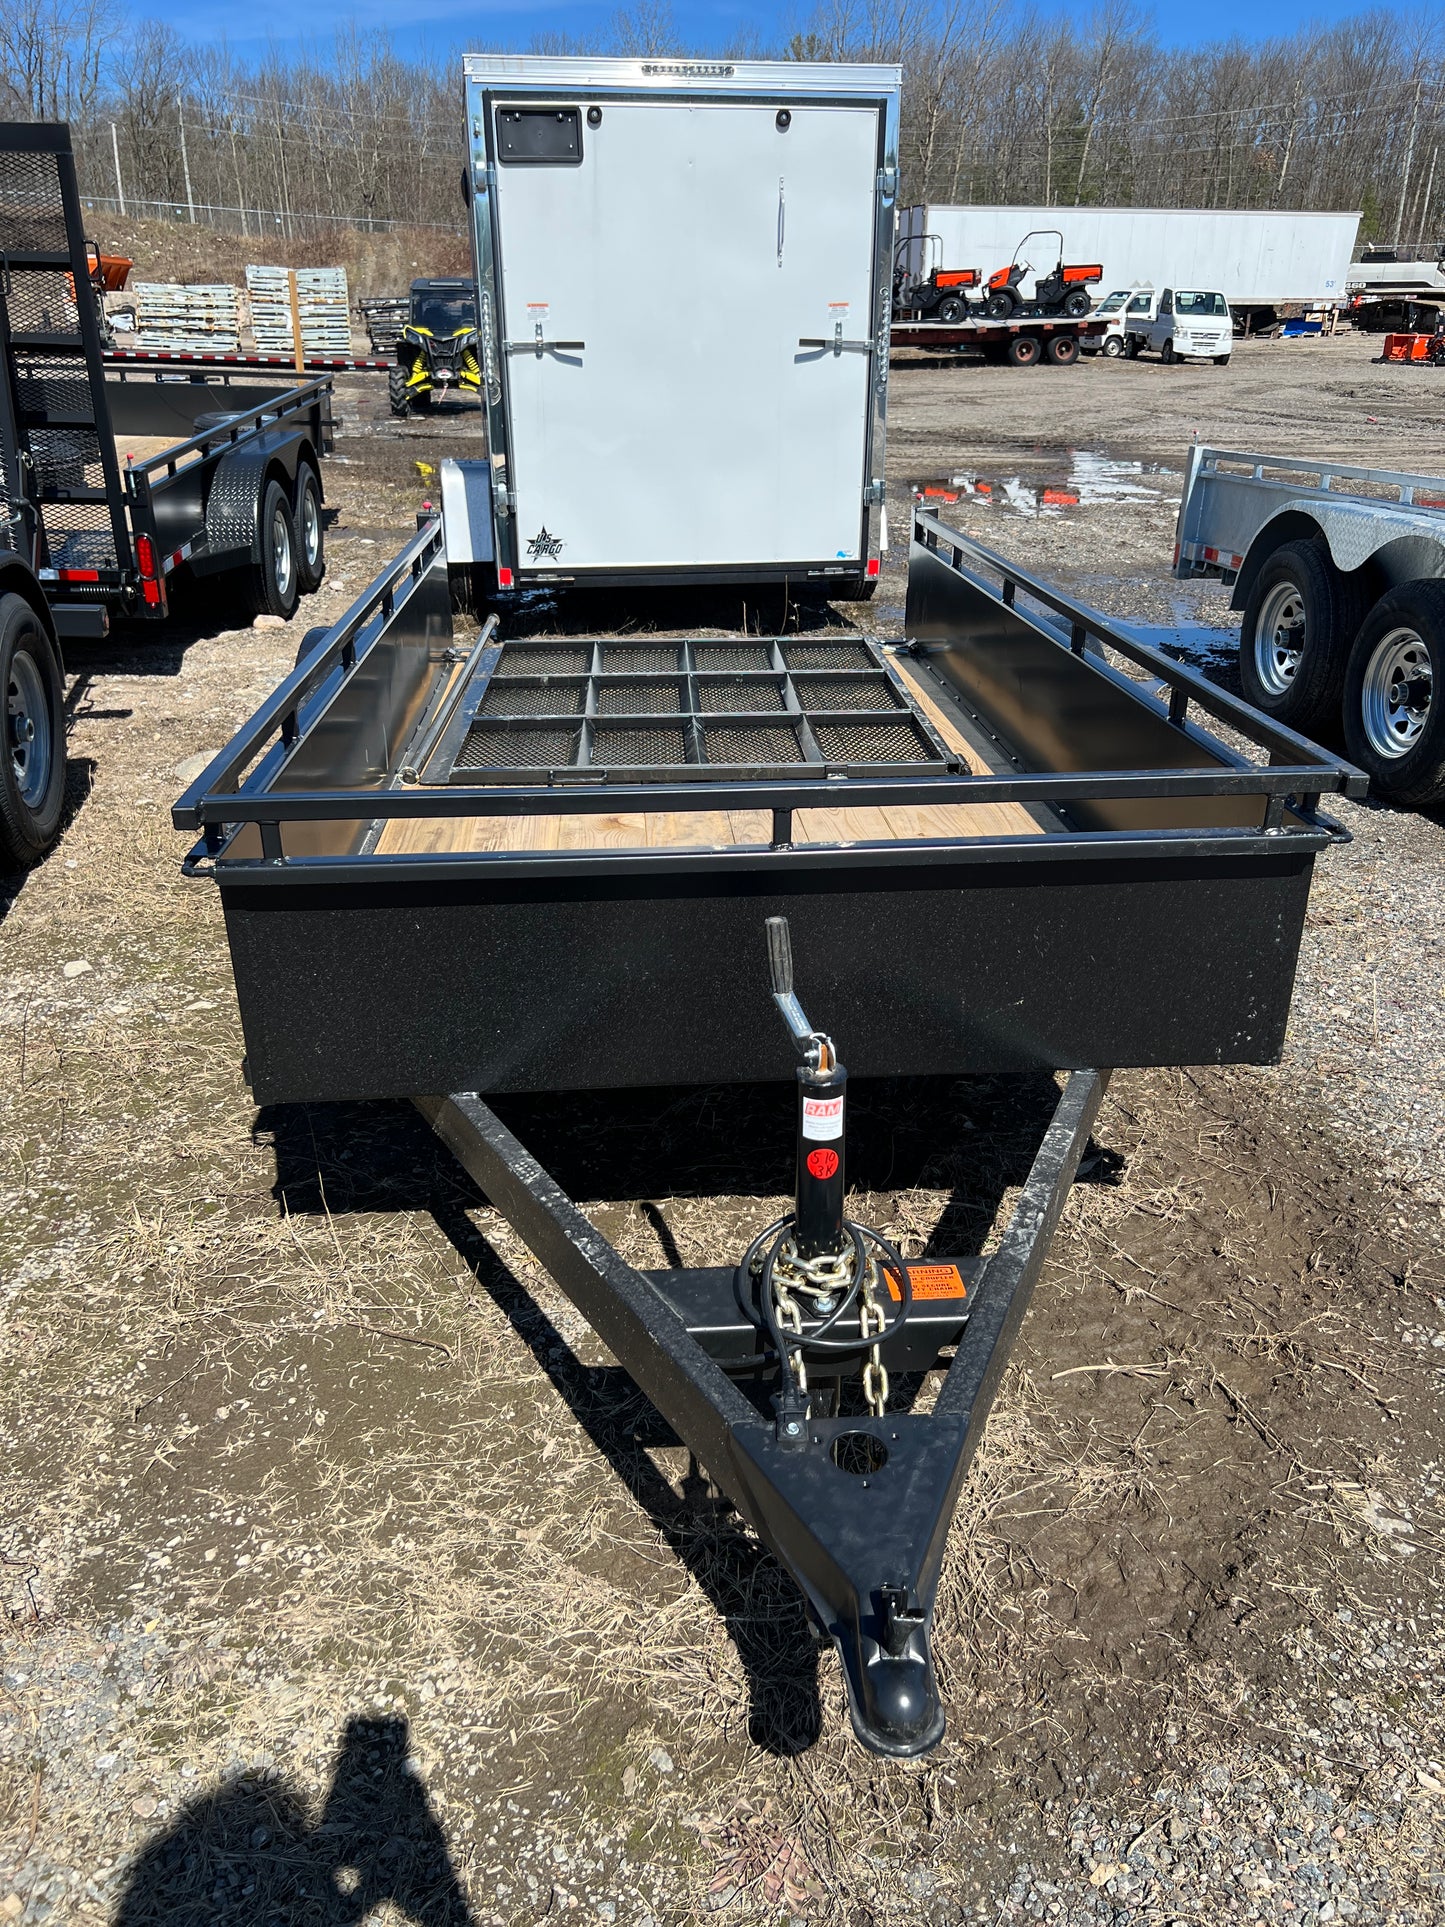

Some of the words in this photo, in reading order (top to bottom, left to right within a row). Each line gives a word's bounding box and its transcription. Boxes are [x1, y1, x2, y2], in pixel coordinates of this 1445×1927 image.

[536, 533, 553, 543] US
[526, 544, 563, 555] CARGO
[805, 1102, 840, 1115] RAM
